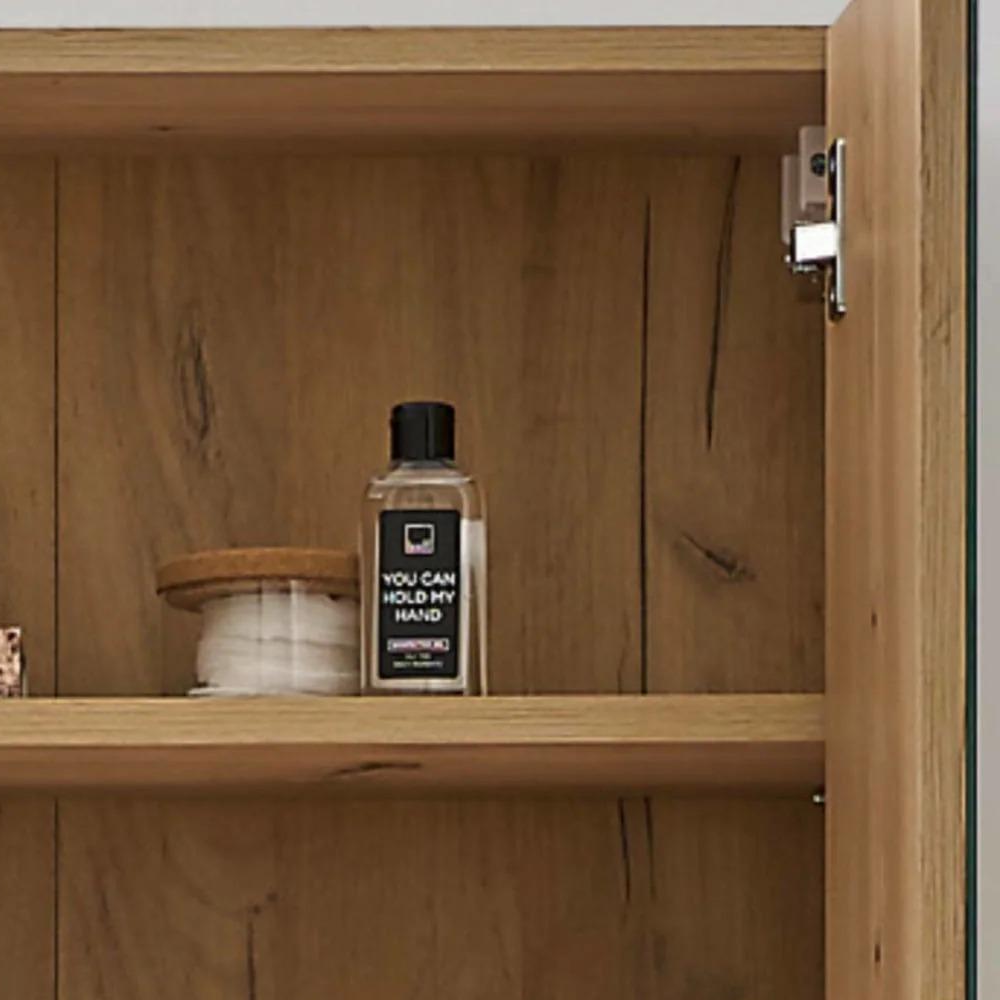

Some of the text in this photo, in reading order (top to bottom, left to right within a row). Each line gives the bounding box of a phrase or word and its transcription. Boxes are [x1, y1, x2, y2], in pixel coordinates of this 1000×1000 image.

[382, 571, 455, 587] YOU CAN
[383, 590, 455, 605] HOLD MY
[395, 608, 442, 622] HAND
